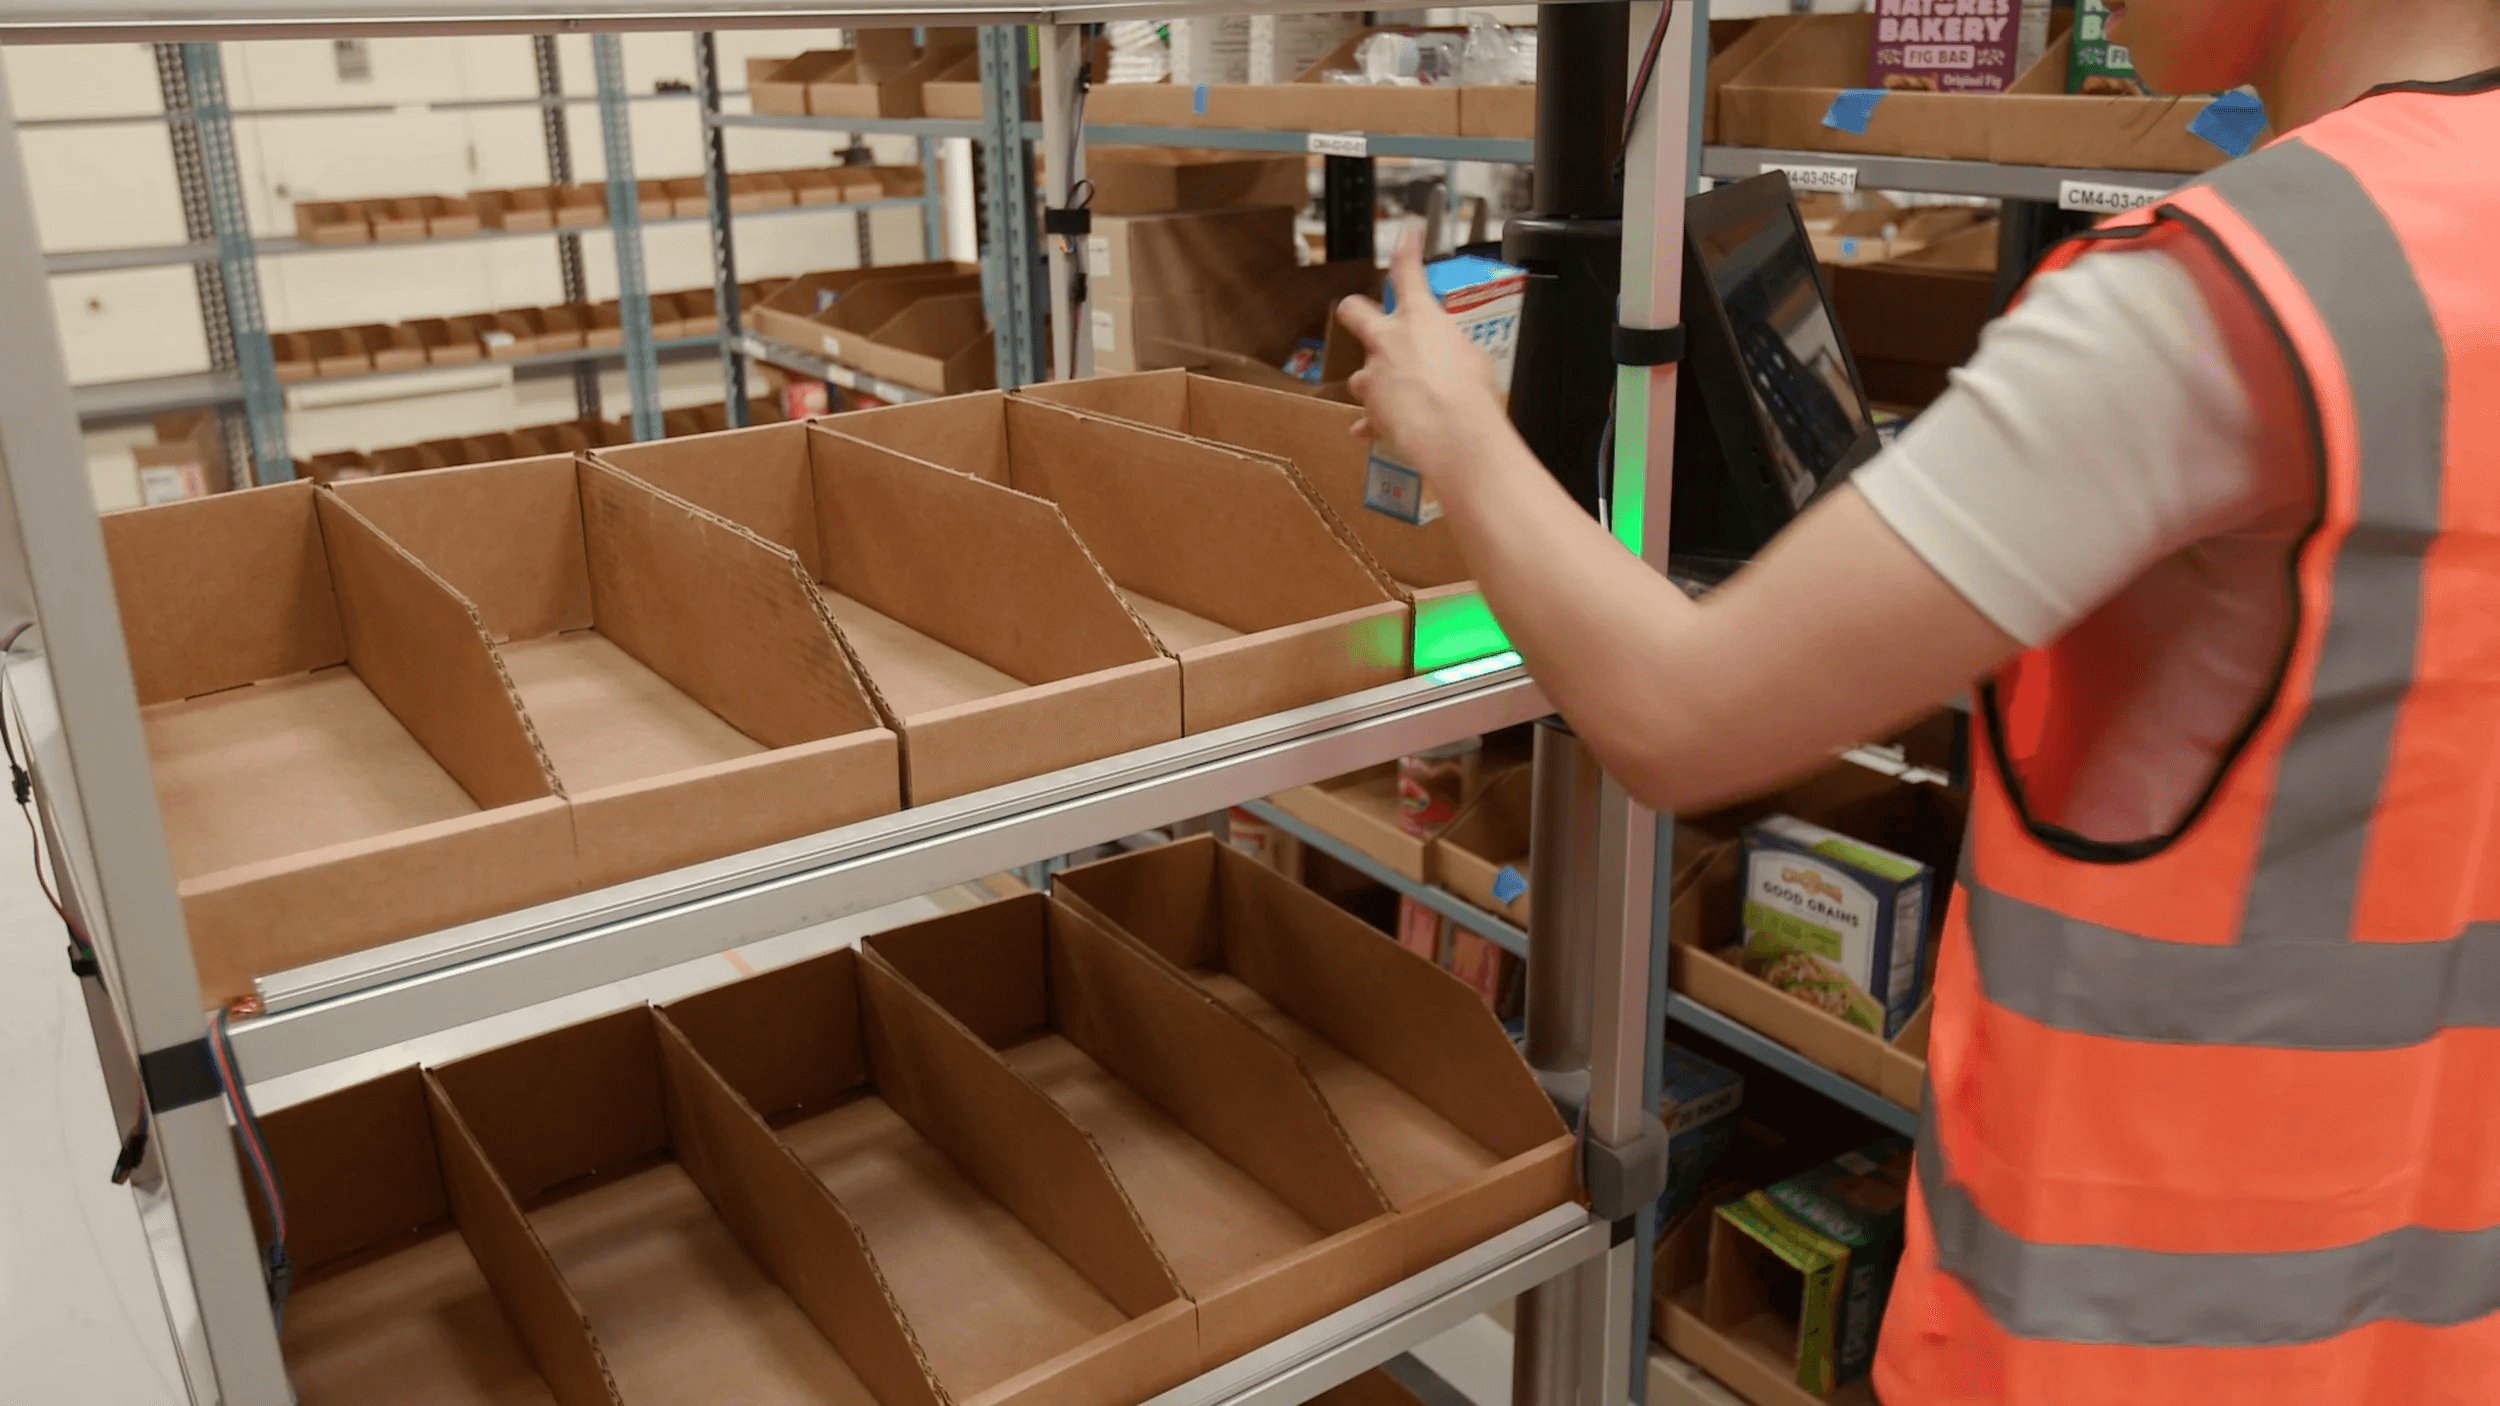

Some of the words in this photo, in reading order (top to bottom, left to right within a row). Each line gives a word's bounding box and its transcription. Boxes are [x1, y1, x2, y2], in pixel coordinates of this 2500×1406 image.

[1879, 17, 2009, 42] BAKERY
[1909, 50, 1933, 64] FIG
[1937, 50, 1969, 63] BAR
[1942, 73, 1984, 90] Original
[1984, 74, 2003, 90] Fig
[1786, 169, 1855, 187] 4-03-05-01
[1763, 881, 1803, 906] GOOD
[1807, 899, 1860, 928] GRAINS
